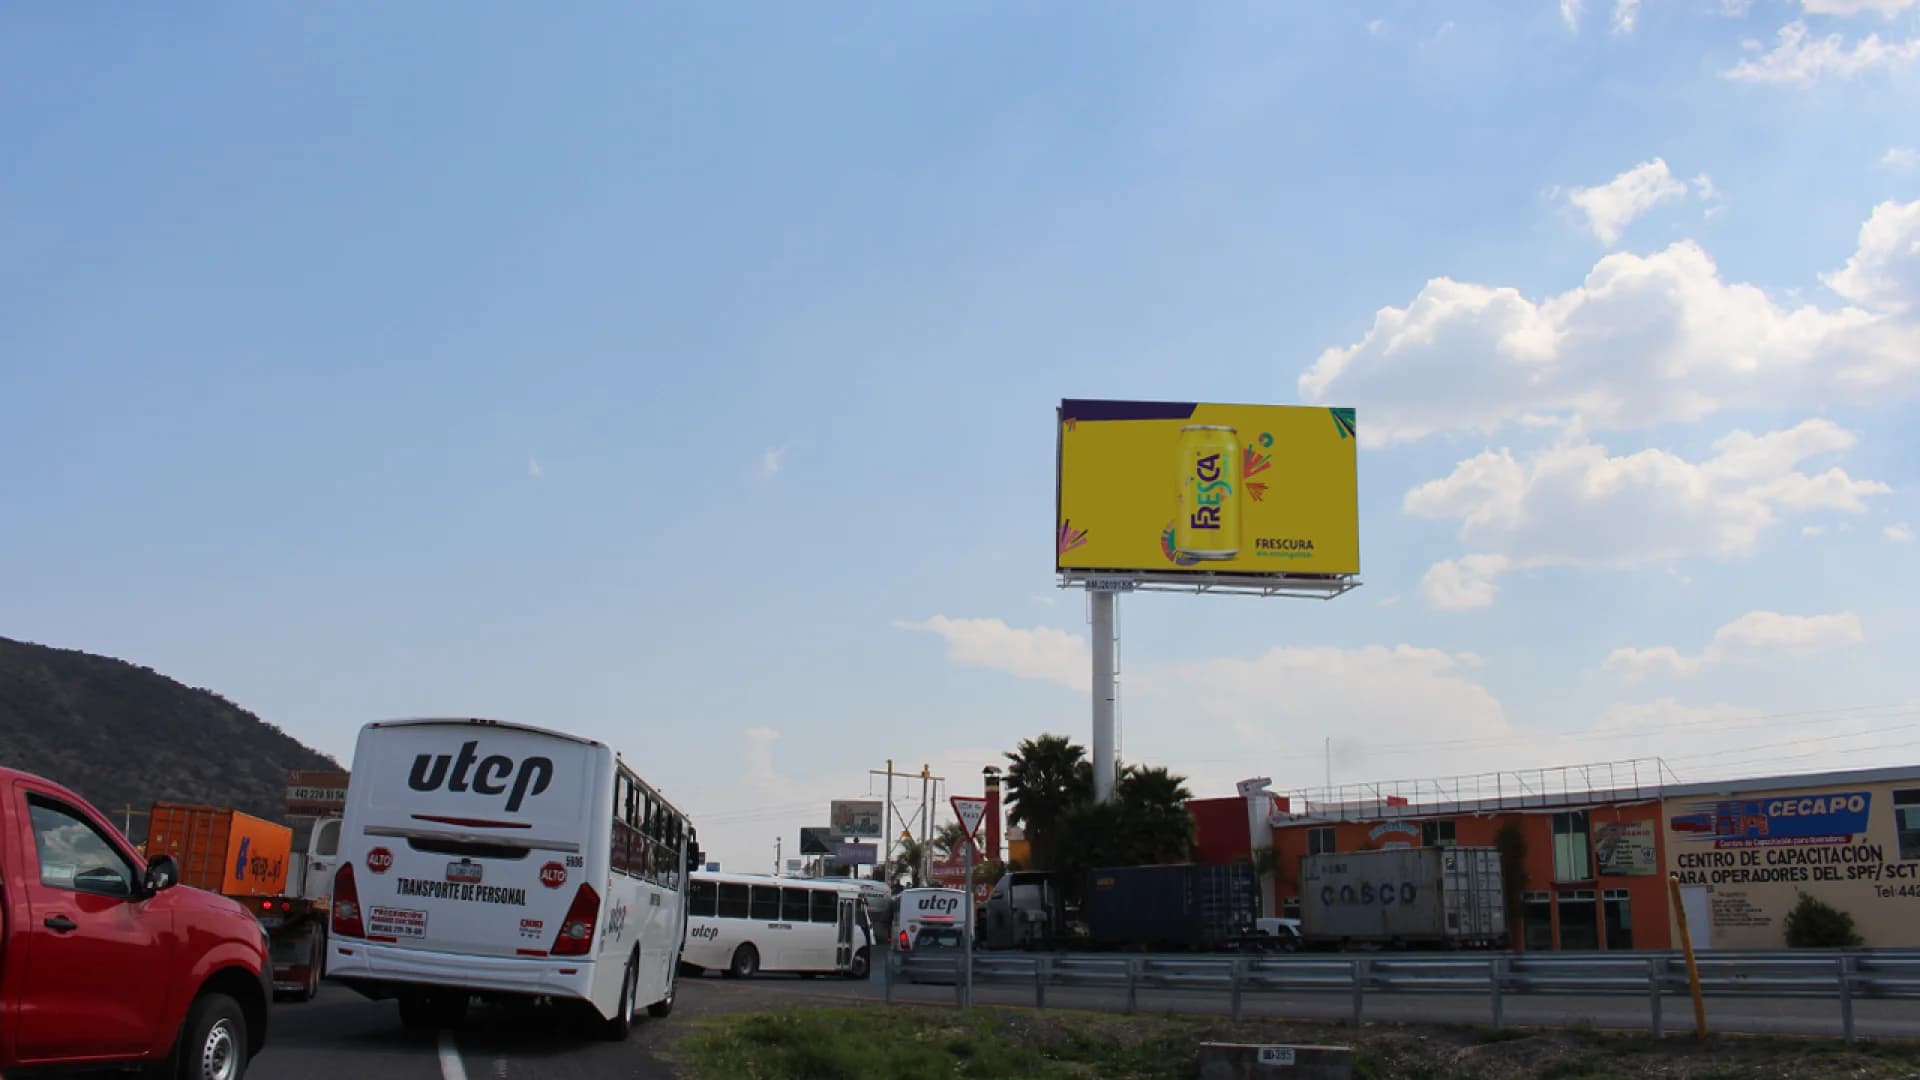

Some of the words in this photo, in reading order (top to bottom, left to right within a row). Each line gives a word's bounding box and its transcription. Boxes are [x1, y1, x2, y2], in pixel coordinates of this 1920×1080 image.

[1190, 453, 1232, 529] FRESCA
[1255, 538, 1314, 551] FRESCURA
[407, 741, 554, 812] utep
[1769, 796, 1864, 817] CECAPO
[369, 854, 392, 867] ALTO
[1678, 850, 1735, 869] CENTRO
[1740, 851, 1760, 866] DE
[1767, 838, 1883, 866] CAPACITACIÓN
[540, 870, 564, 882] ALTO
[1711, 866, 1809, 884] OPERADORES
[1814, 866, 1843, 882] DEL
[397, 877, 460, 900] TRANSPORTE
[461, 884, 474, 901] DE
[476, 887, 526, 907] PERSONAL
[1320, 882, 1417, 907] COSCO
[918, 895, 958, 914] utep
